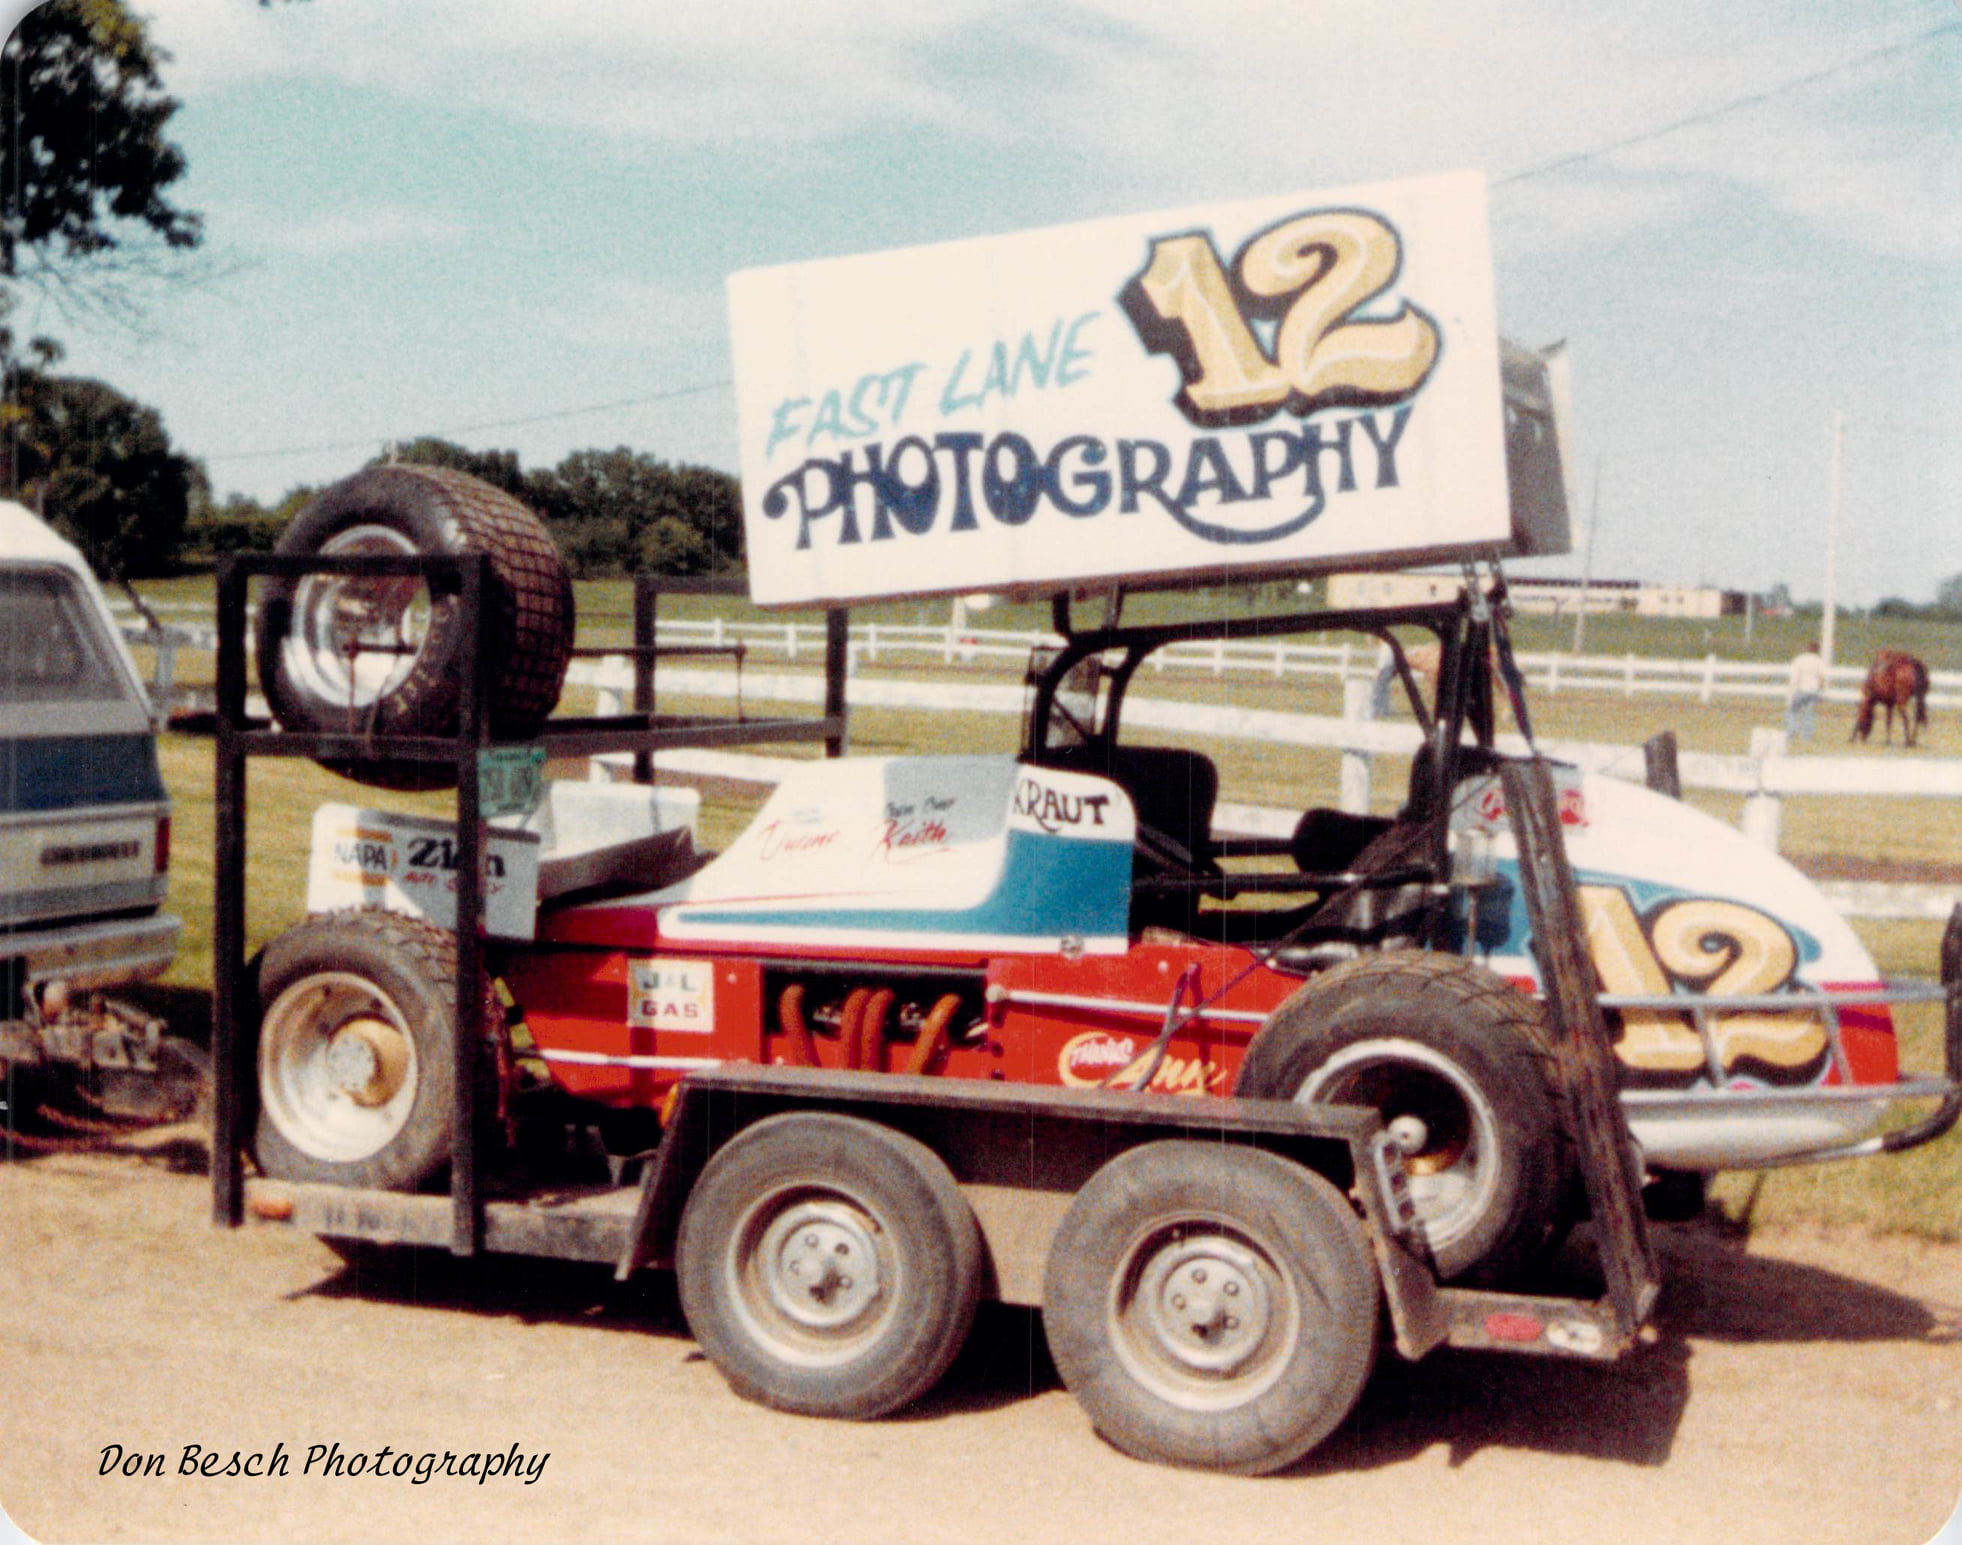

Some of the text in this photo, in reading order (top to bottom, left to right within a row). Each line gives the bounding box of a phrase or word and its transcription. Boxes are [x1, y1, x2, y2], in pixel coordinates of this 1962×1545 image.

[767, 311, 1102, 457] FAST LANE
[1116, 207, 1443, 428] 12
[762, 408, 1414, 549] PHOTOGRAPHY
[333, 842, 389, 871] NAPA
[640, 998, 699, 1018] GAS
